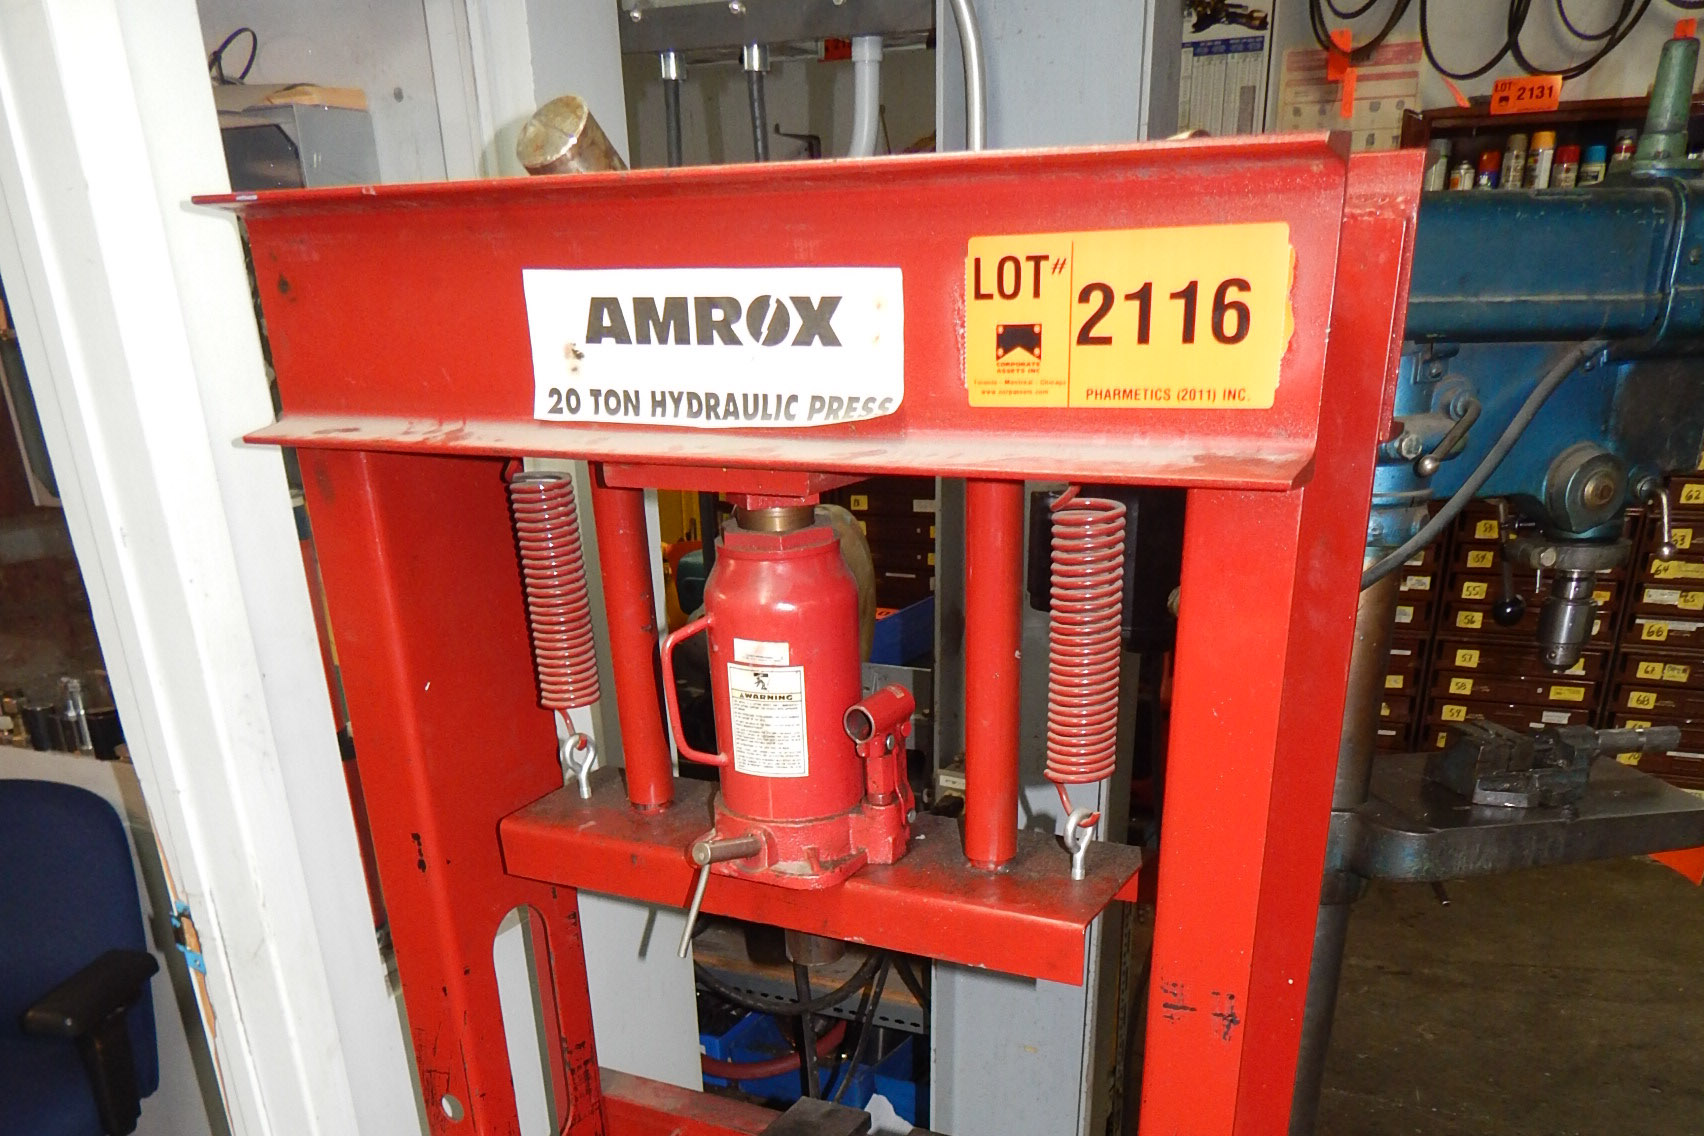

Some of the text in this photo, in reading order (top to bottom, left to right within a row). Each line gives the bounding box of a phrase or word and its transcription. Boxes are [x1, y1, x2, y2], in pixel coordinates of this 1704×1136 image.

[1516, 85, 1553, 101] 2131
[1076, 278, 1252, 346] 2116
[585, 295, 842, 347] AMROX
[1085, 388, 1251, 403] PHARMETICS (2011) INC.
[548, 387, 894, 421] 20 TON HYDRAULIC PRESS
[1465, 585, 1480, 597] 55
[1646, 624, 1664, 638] 66
[745, 693, 793, 701] WARNING
